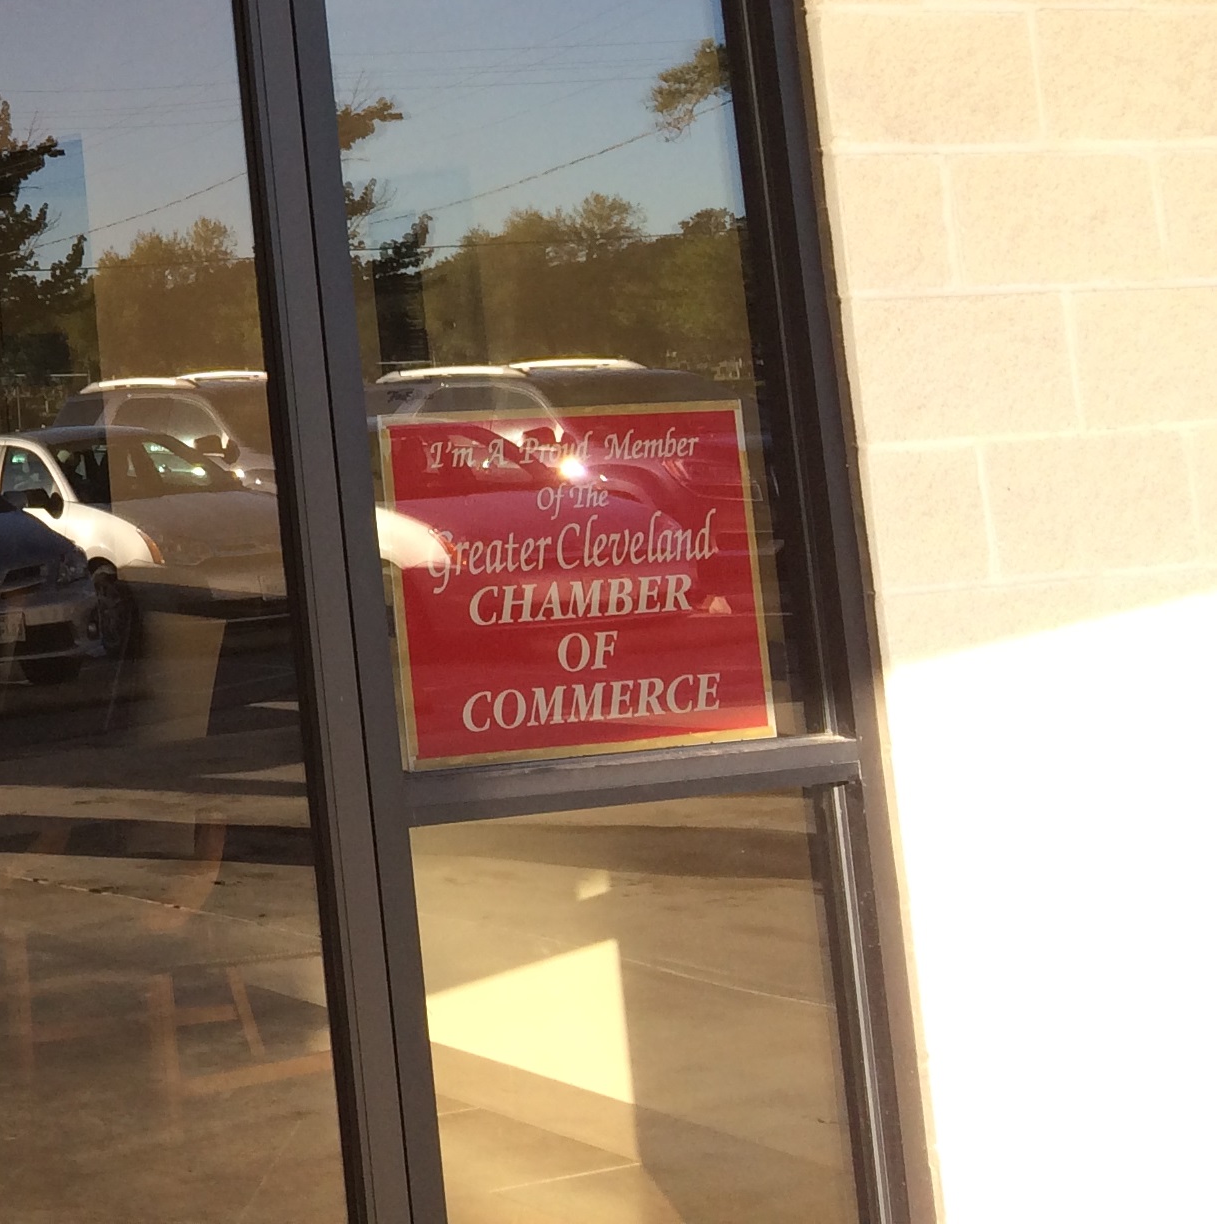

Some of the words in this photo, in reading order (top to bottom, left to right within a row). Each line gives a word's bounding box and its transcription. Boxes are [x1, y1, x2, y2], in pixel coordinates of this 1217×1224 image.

[430, 440, 476, 469] I'm
[487, 437, 511, 467] A
[519, 431, 593, 465] Proud
[604, 427, 700, 460] Member
[536, 483, 568, 521] Of
[568, 484, 610, 509] The
[556, 508, 718, 570] Cleveland
[469, 574, 693, 626] CHAMBER
[557, 630, 619, 673] OF
[462, 672, 722, 733] COMMERCE
